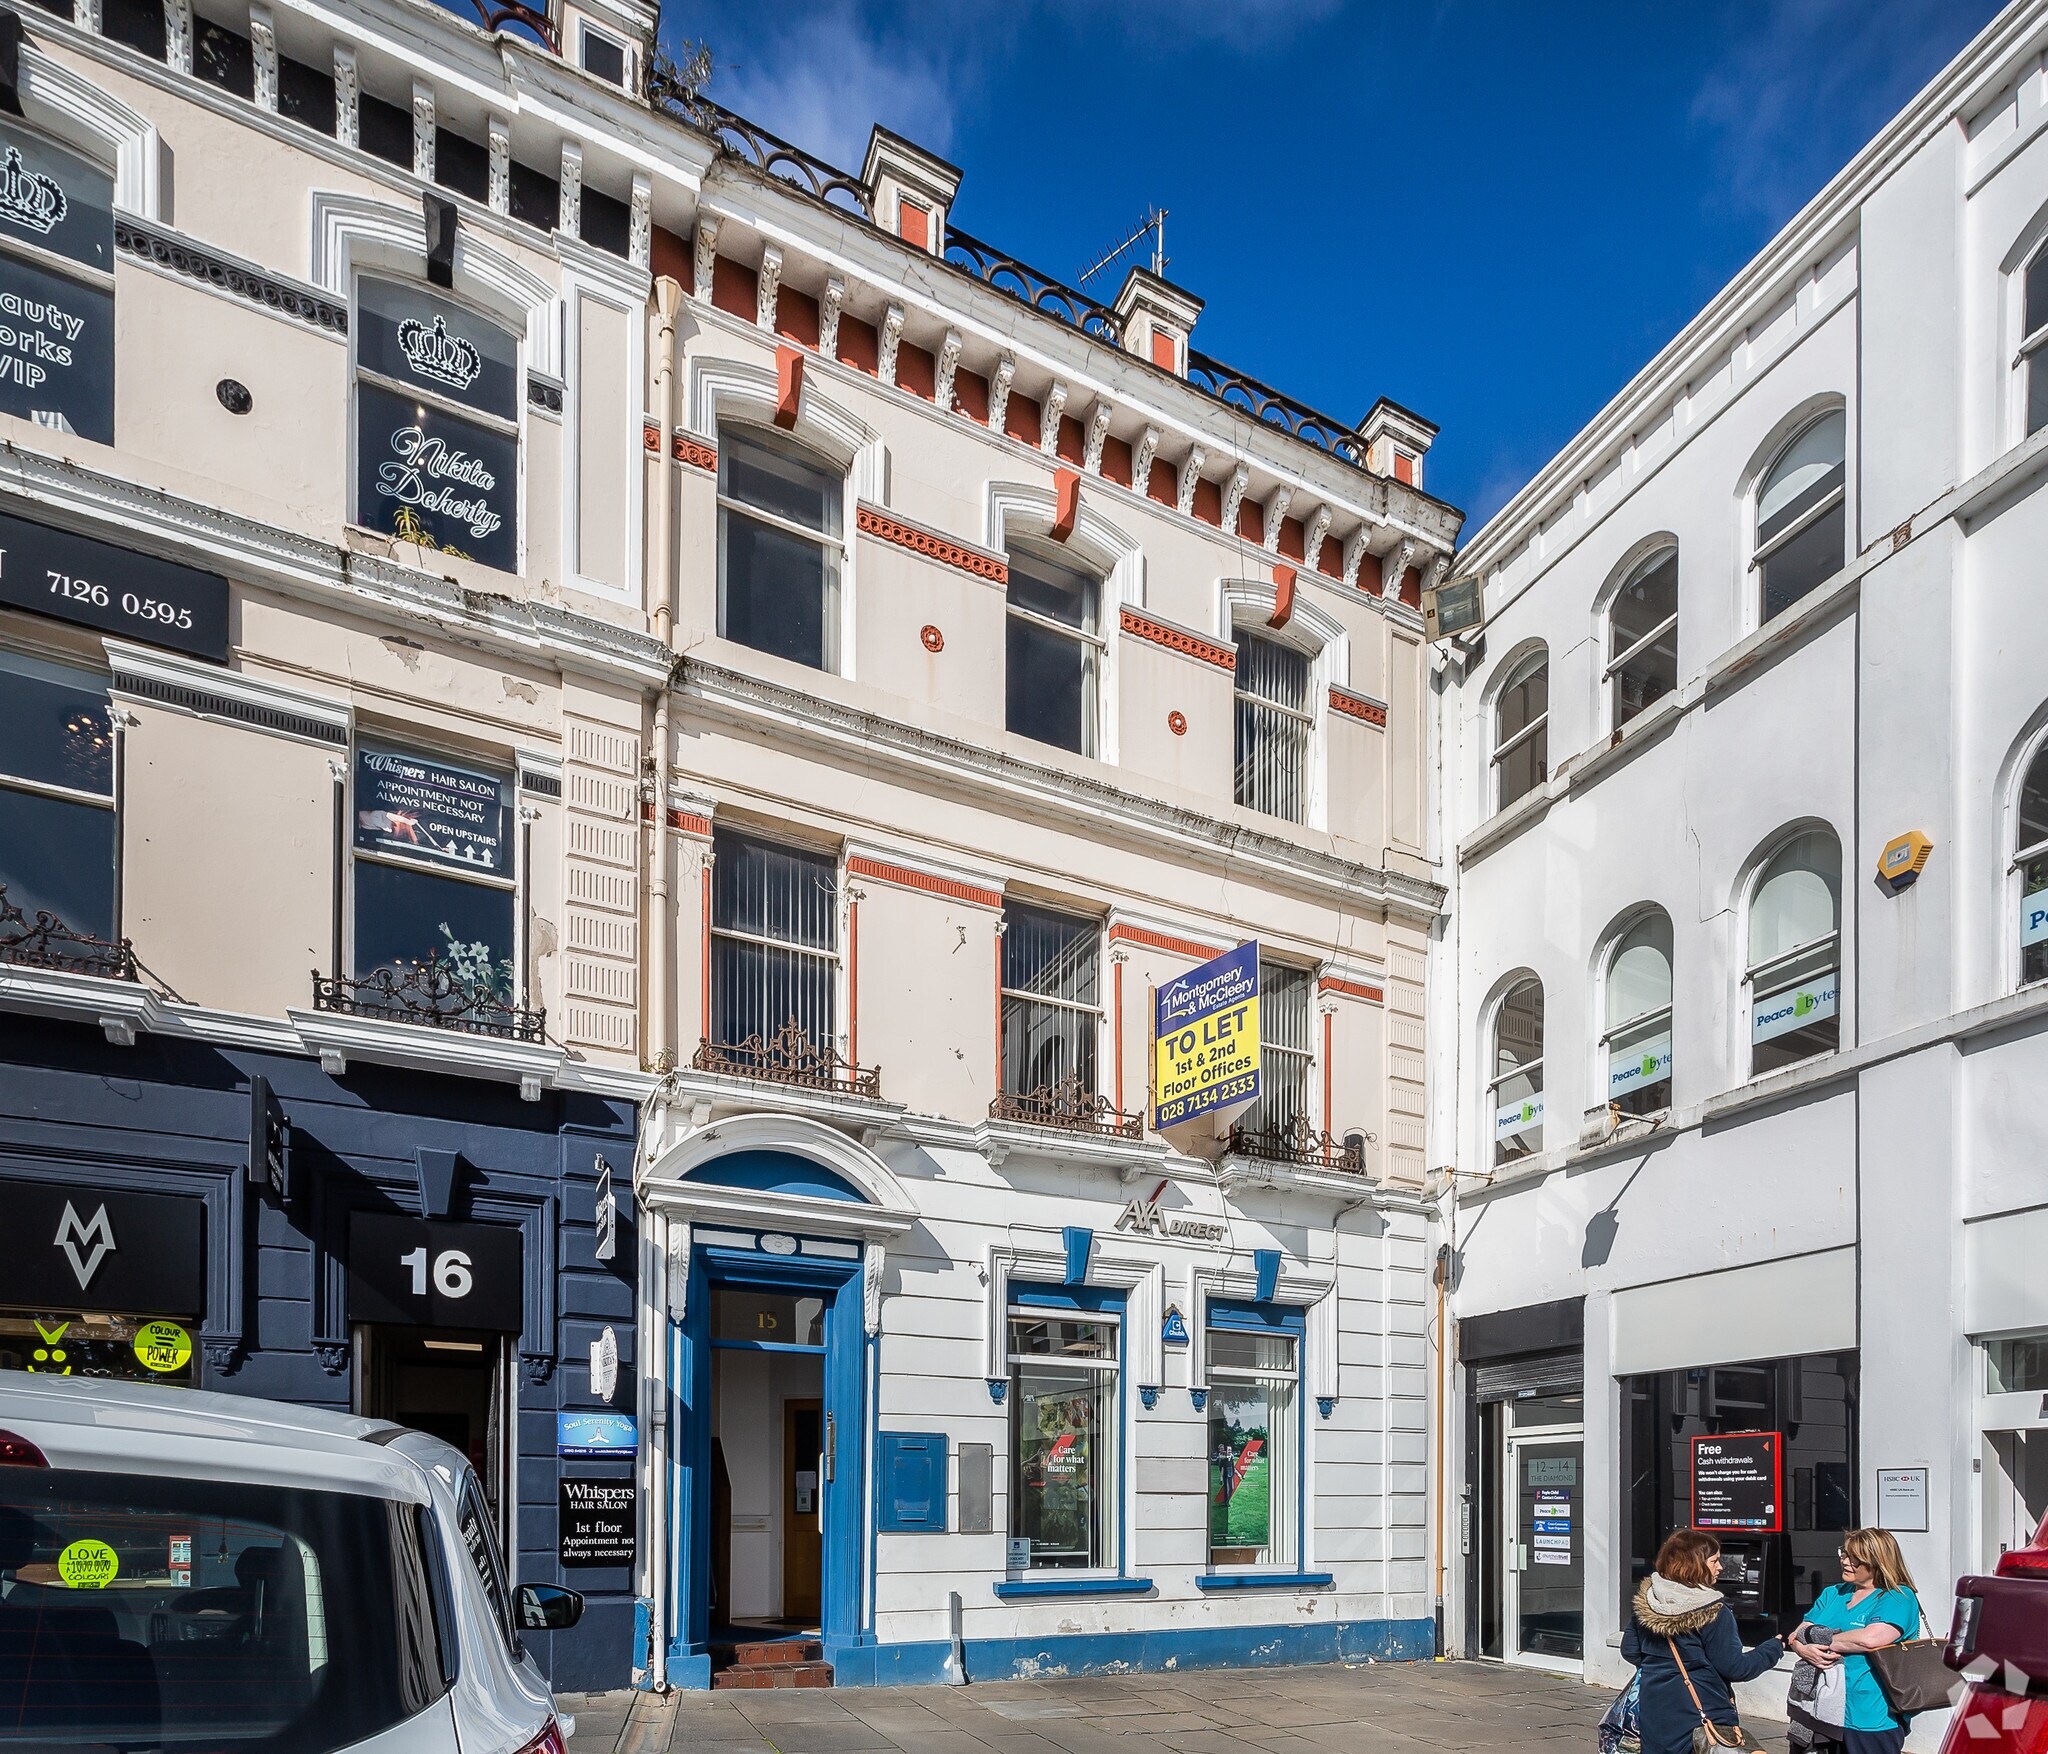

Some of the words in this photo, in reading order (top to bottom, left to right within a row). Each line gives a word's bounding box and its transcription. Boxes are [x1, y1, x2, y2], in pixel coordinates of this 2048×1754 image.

[0, 293, 85, 341] auty
[0, 325, 73, 366] orks
[391, 426, 495, 490] Nikita
[376, 461, 501, 538] Doherty
[46, 570, 109, 607] 7126
[121, 593, 192, 629] 0595
[364, 752, 426, 780] Whispers
[431, 772, 457, 788] HAIR
[459, 780, 496, 797] SALON
[377, 779, 457, 806] APPOINTMENT
[460, 800, 484, 812] NOT
[376, 791, 420, 808] ALWAYS
[422, 801, 486, 824] NECESSARY
[429, 822, 454, 836] OPEN
[456, 829, 497, 847] UPSTAIRS
[2030, 910, 2048, 930] P
[1172, 966, 1243, 1008] Montgomery
[1188, 1001, 1197, 1015] &
[1199, 977, 1254, 1011] McCleery
[1212, 1001, 1227, 1011] Estate
[1756, 1006, 1794, 1027] Peace
[1165, 1030, 1196, 1061] TO
[1203, 1006, 1248, 1046] LET
[1175, 1059, 1193, 1076] 1st
[1196, 1052, 1205, 1067] &
[1209, 1040, 1236, 1063] 2nd
[1163, 1076, 1197, 1099] Floor
[1200, 1056, 1251, 1085] Offices
[1612, 1066, 1641, 1083] Peace
[1161, 1101, 1185, 1122] 028
[1187, 1090, 1218, 1112] 7134
[1221, 1074, 1255, 1100] 2333
[1498, 1113, 1521, 1127] Peace
[1114, 1199, 1169, 1237] AXA
[1169, 1220, 1224, 1241] DIRECT
[401, 1247, 473, 1298] 16
[758, 1311, 777, 1329] 15
[150, 1324, 181, 1338] COLOUR
[147, 1345, 179, 1364] POWER
[563, 1420, 581, 1431] Soul
[582, 1418, 615, 1427] Serenity
[616, 1420, 633, 1433] Yoga
[1053, 1455, 1065, 1463] for
[1066, 1455, 1084, 1463] what
[1058, 1445, 1075, 1454] Care
[1698, 1444, 1722, 1455] Free
[1047, 1465, 1076, 1473] matters
[1536, 1461, 1546, 1472] 12
[1558, 1460, 1569, 1472] 14
[1698, 1457, 1713, 1465] Cash
[1714, 1456, 1754, 1464] withdrawals
[1544, 1474, 1573, 1482] DIAMOND
[563, 1483, 635, 1502] Whispers
[570, 1501, 594, 1509] HAIR
[597, 1501, 628, 1510] SALON
[576, 1522, 590, 1533] 1st
[563, 1536, 618, 1547] Appointment
[622, 1537, 634, 1545] not
[68, 1548, 108, 1560] LOVE
[563, 1549, 591, 1559] always
[595, 1549, 633, 1559] necessary
